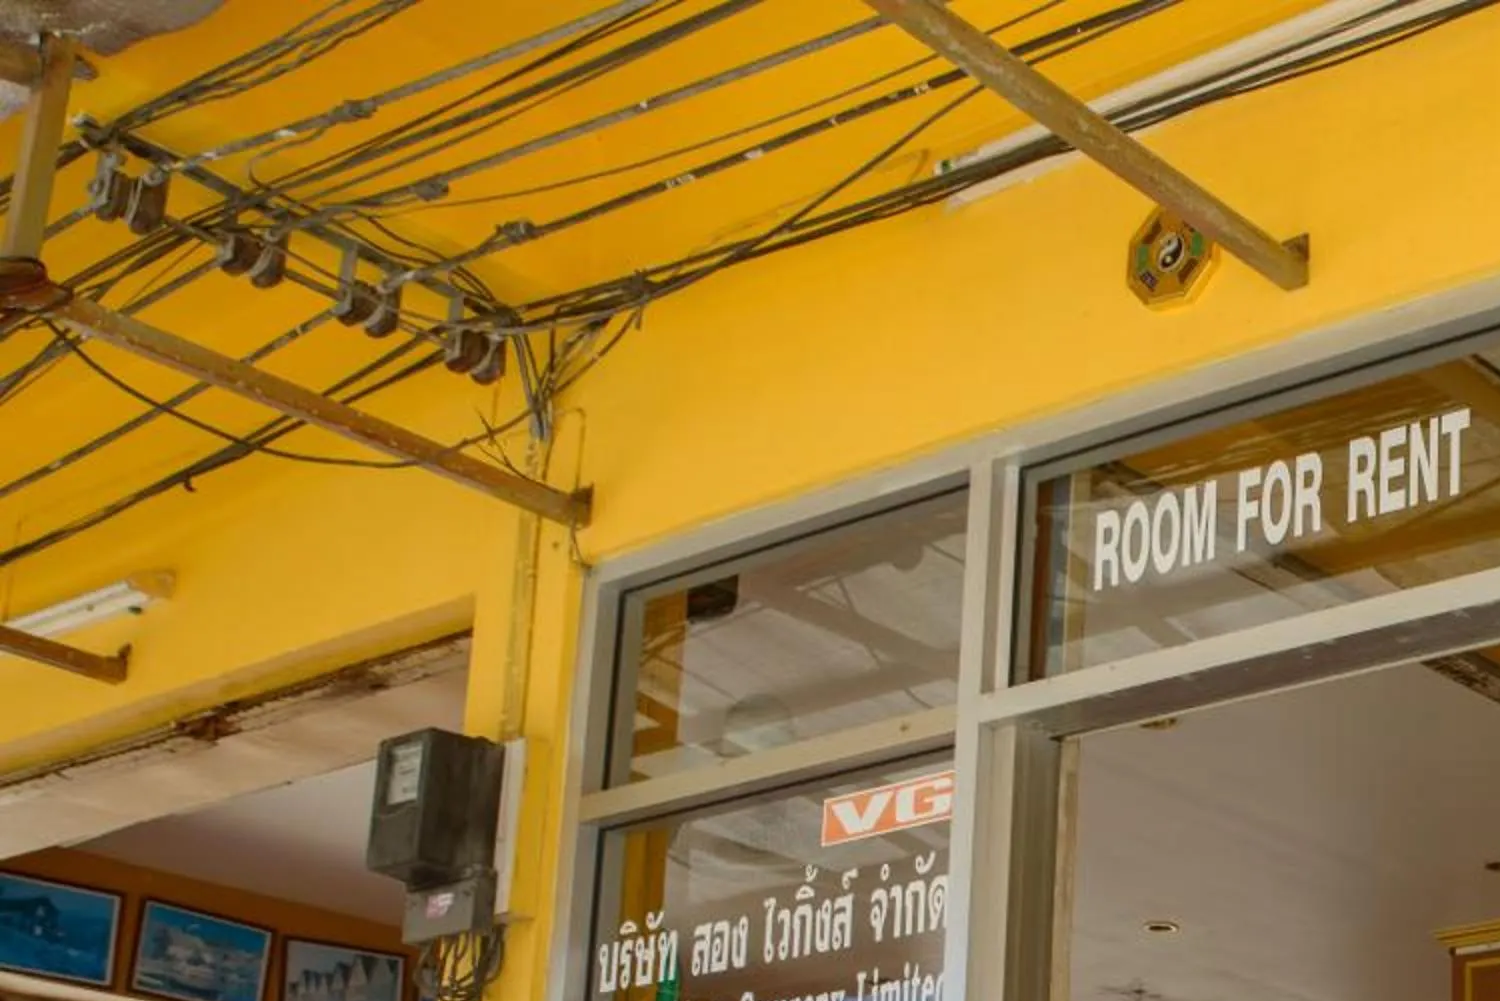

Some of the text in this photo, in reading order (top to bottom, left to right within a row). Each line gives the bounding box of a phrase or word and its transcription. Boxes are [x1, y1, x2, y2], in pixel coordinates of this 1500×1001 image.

[1093, 407, 1471, 592] ROOM FOR RENT
[832, 776, 953, 835] VG
[598, 911, 679, 993] บริษัท
[690, 914, 749, 977] สอง
